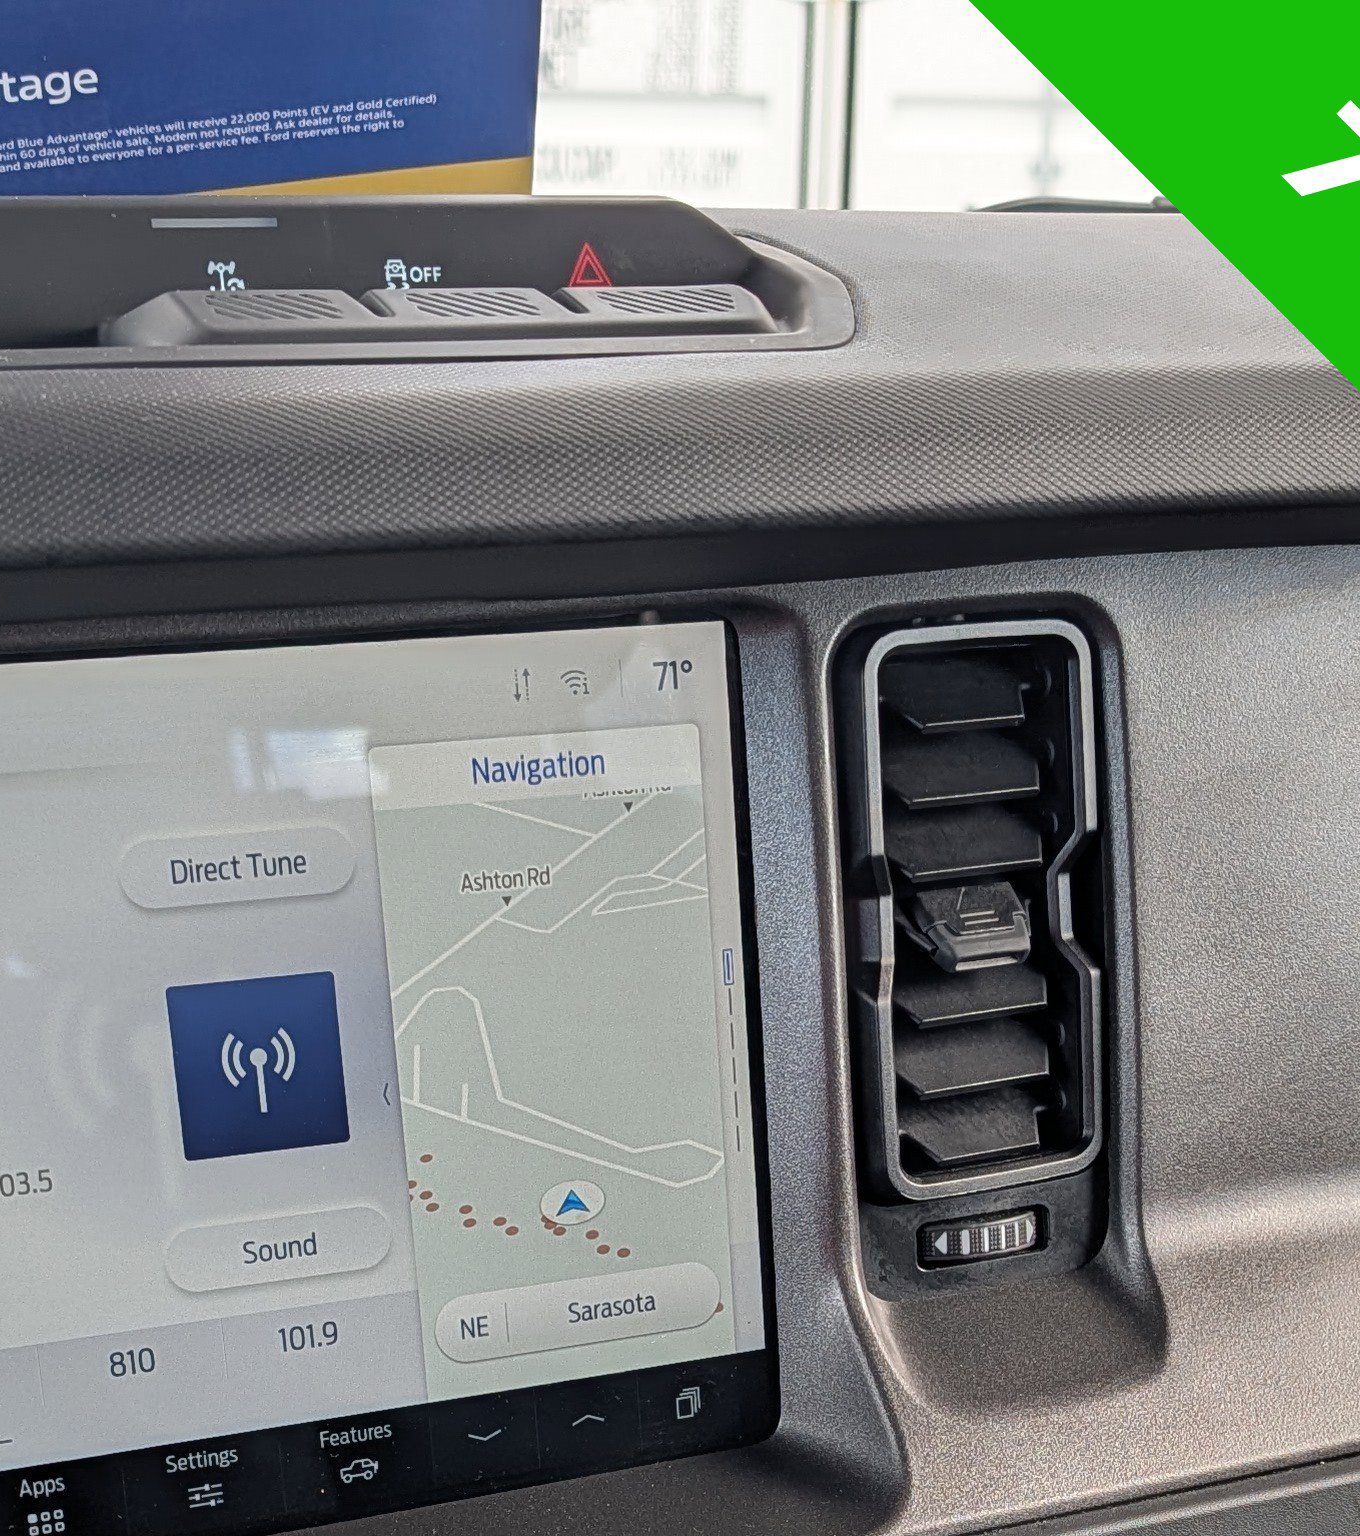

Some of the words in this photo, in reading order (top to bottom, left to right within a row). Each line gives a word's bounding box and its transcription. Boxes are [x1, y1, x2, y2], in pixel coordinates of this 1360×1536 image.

[17, 135, 43, 149] Blue
[115, 122, 162, 138] vehicles
[164, 119, 186, 132] will
[187, 114, 228, 130] receive
[230, 110, 271, 127] 22,000
[272, 106, 309, 120] Points
[310, 103, 331, 119] (EV
[331, 101, 354, 114] and
[356, 98, 383, 112] Gold
[385, 93, 438, 111] Certified)
[19, 147, 37, 160] 60
[38, 144, 67, 160] days
[69, 142, 81, 154] of
[82, 137, 123, 153] vehicle
[125, 134, 151, 148] sale.
[199, 126, 220, 140] not
[221, 121, 273, 139] required.
[274, 118, 296, 131] Ask
[298, 114, 333, 129] dealer
[335, 112, 352, 125] for
[354, 108, 396, 123] details.
[0, 160, 21, 173] and
[23, 154, 75, 171] available
[77, 152, 90, 164] to
[91, 148, 145, 165] everyone
[146, 144, 164, 156] for
[165, 145, 174, 154] a
[175, 135, 239, 155] per-service
[240, 133, 262, 146] fee.
[263, 130, 290, 143] Ford
[292, 127, 340, 140] reserves
[341, 122, 361, 135] the
[362, 119, 391, 135] right
[392, 118, 405, 130] to
[410, 266, 442, 283] OFF
[471, 750, 606, 786] Navigation
[170, 853, 241, 885] Direct
[247, 849, 308, 880] Tune
[459, 869, 525, 893] Ashton
[527, 866, 551, 888] Rd
[241, 1232, 318, 1265] Sound
[567, 1291, 657, 1326] Sarasota
[277, 1320, 340, 1353] 101.9
[459, 1315, 490, 1340] NE
[108, 1346, 157, 1378] 810
[318, 1421, 394, 1450] Features
[165, 1445, 240, 1477] Settings
[18, 1474, 66, 1501] Apps
